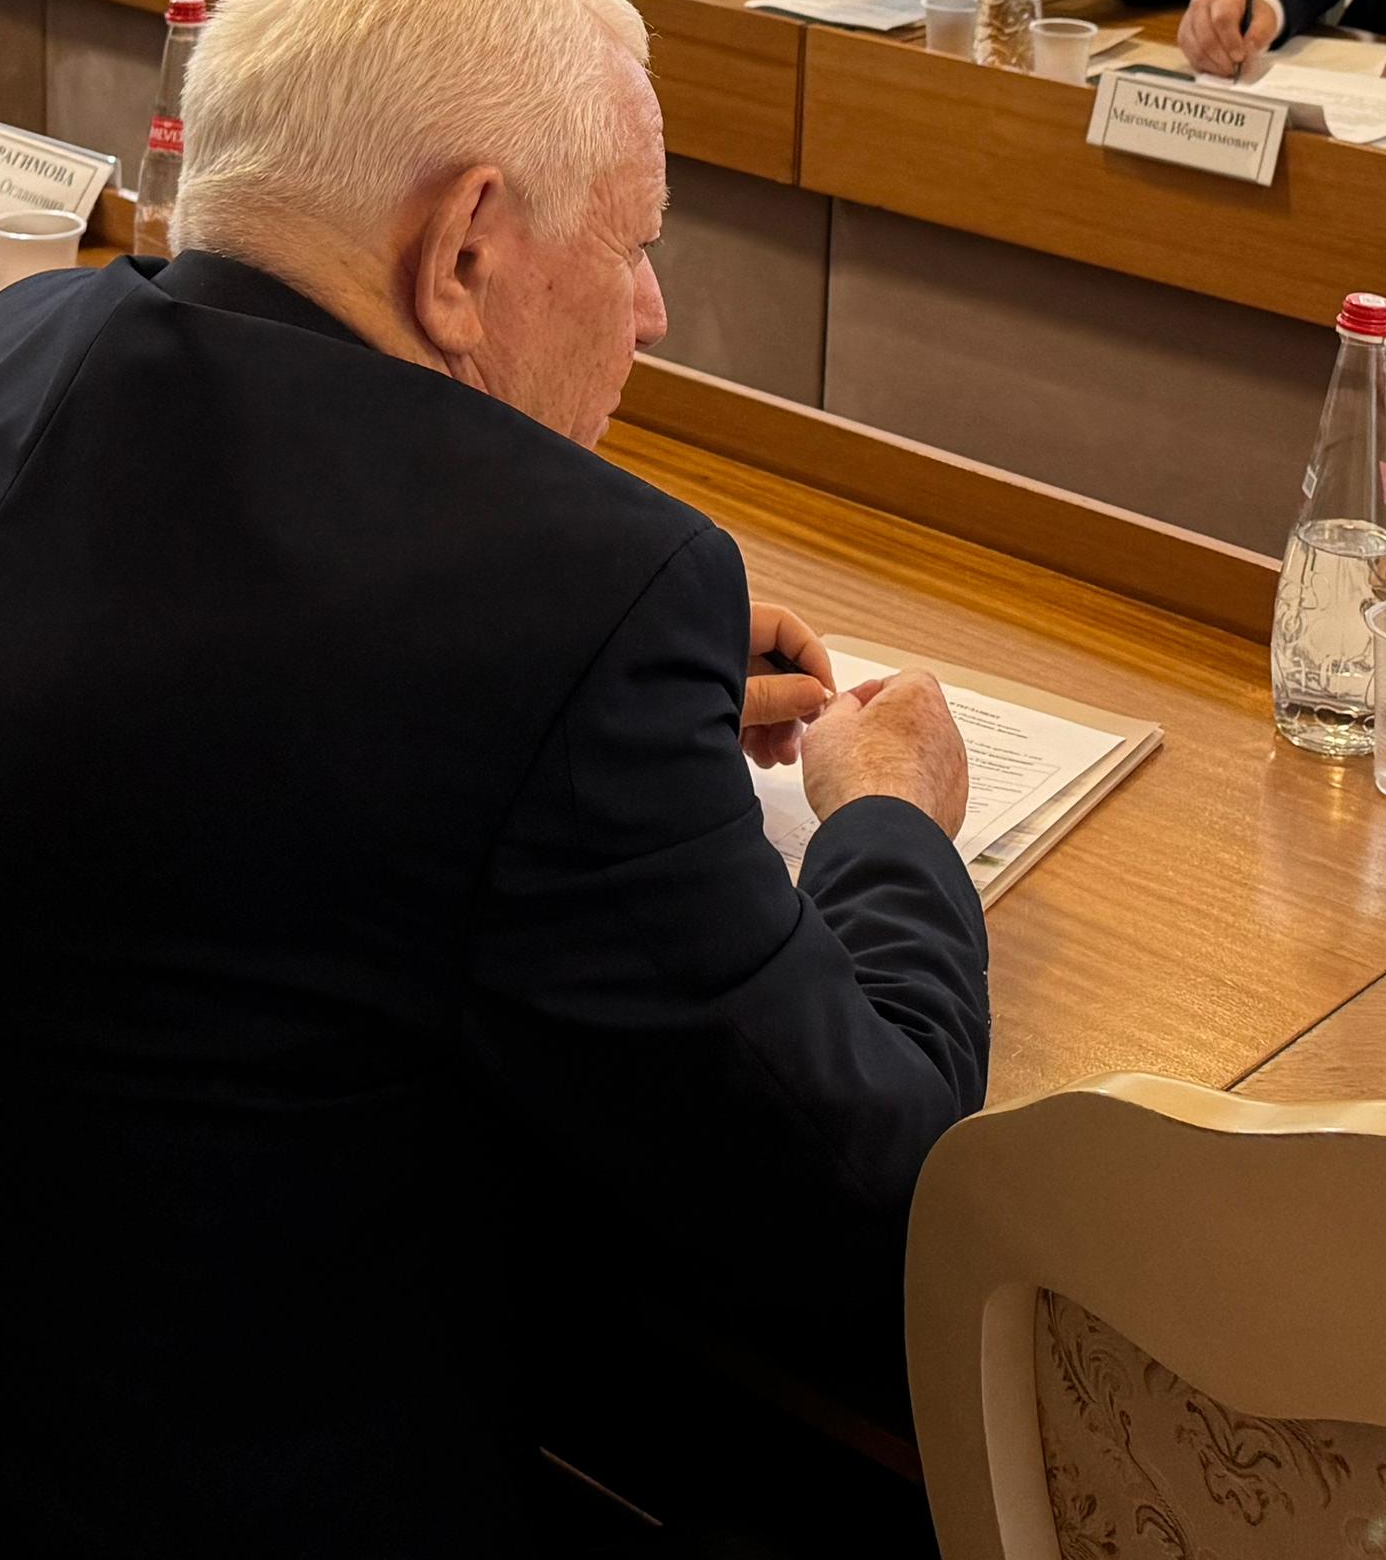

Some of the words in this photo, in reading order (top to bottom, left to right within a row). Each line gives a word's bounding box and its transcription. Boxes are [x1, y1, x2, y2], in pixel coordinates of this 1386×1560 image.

[1110, 107, 1168, 133] Магомед
[1170, 120, 1259, 153] Ибрагимович
[1135, 90, 1246, 128] МАГОМЕДОВ
